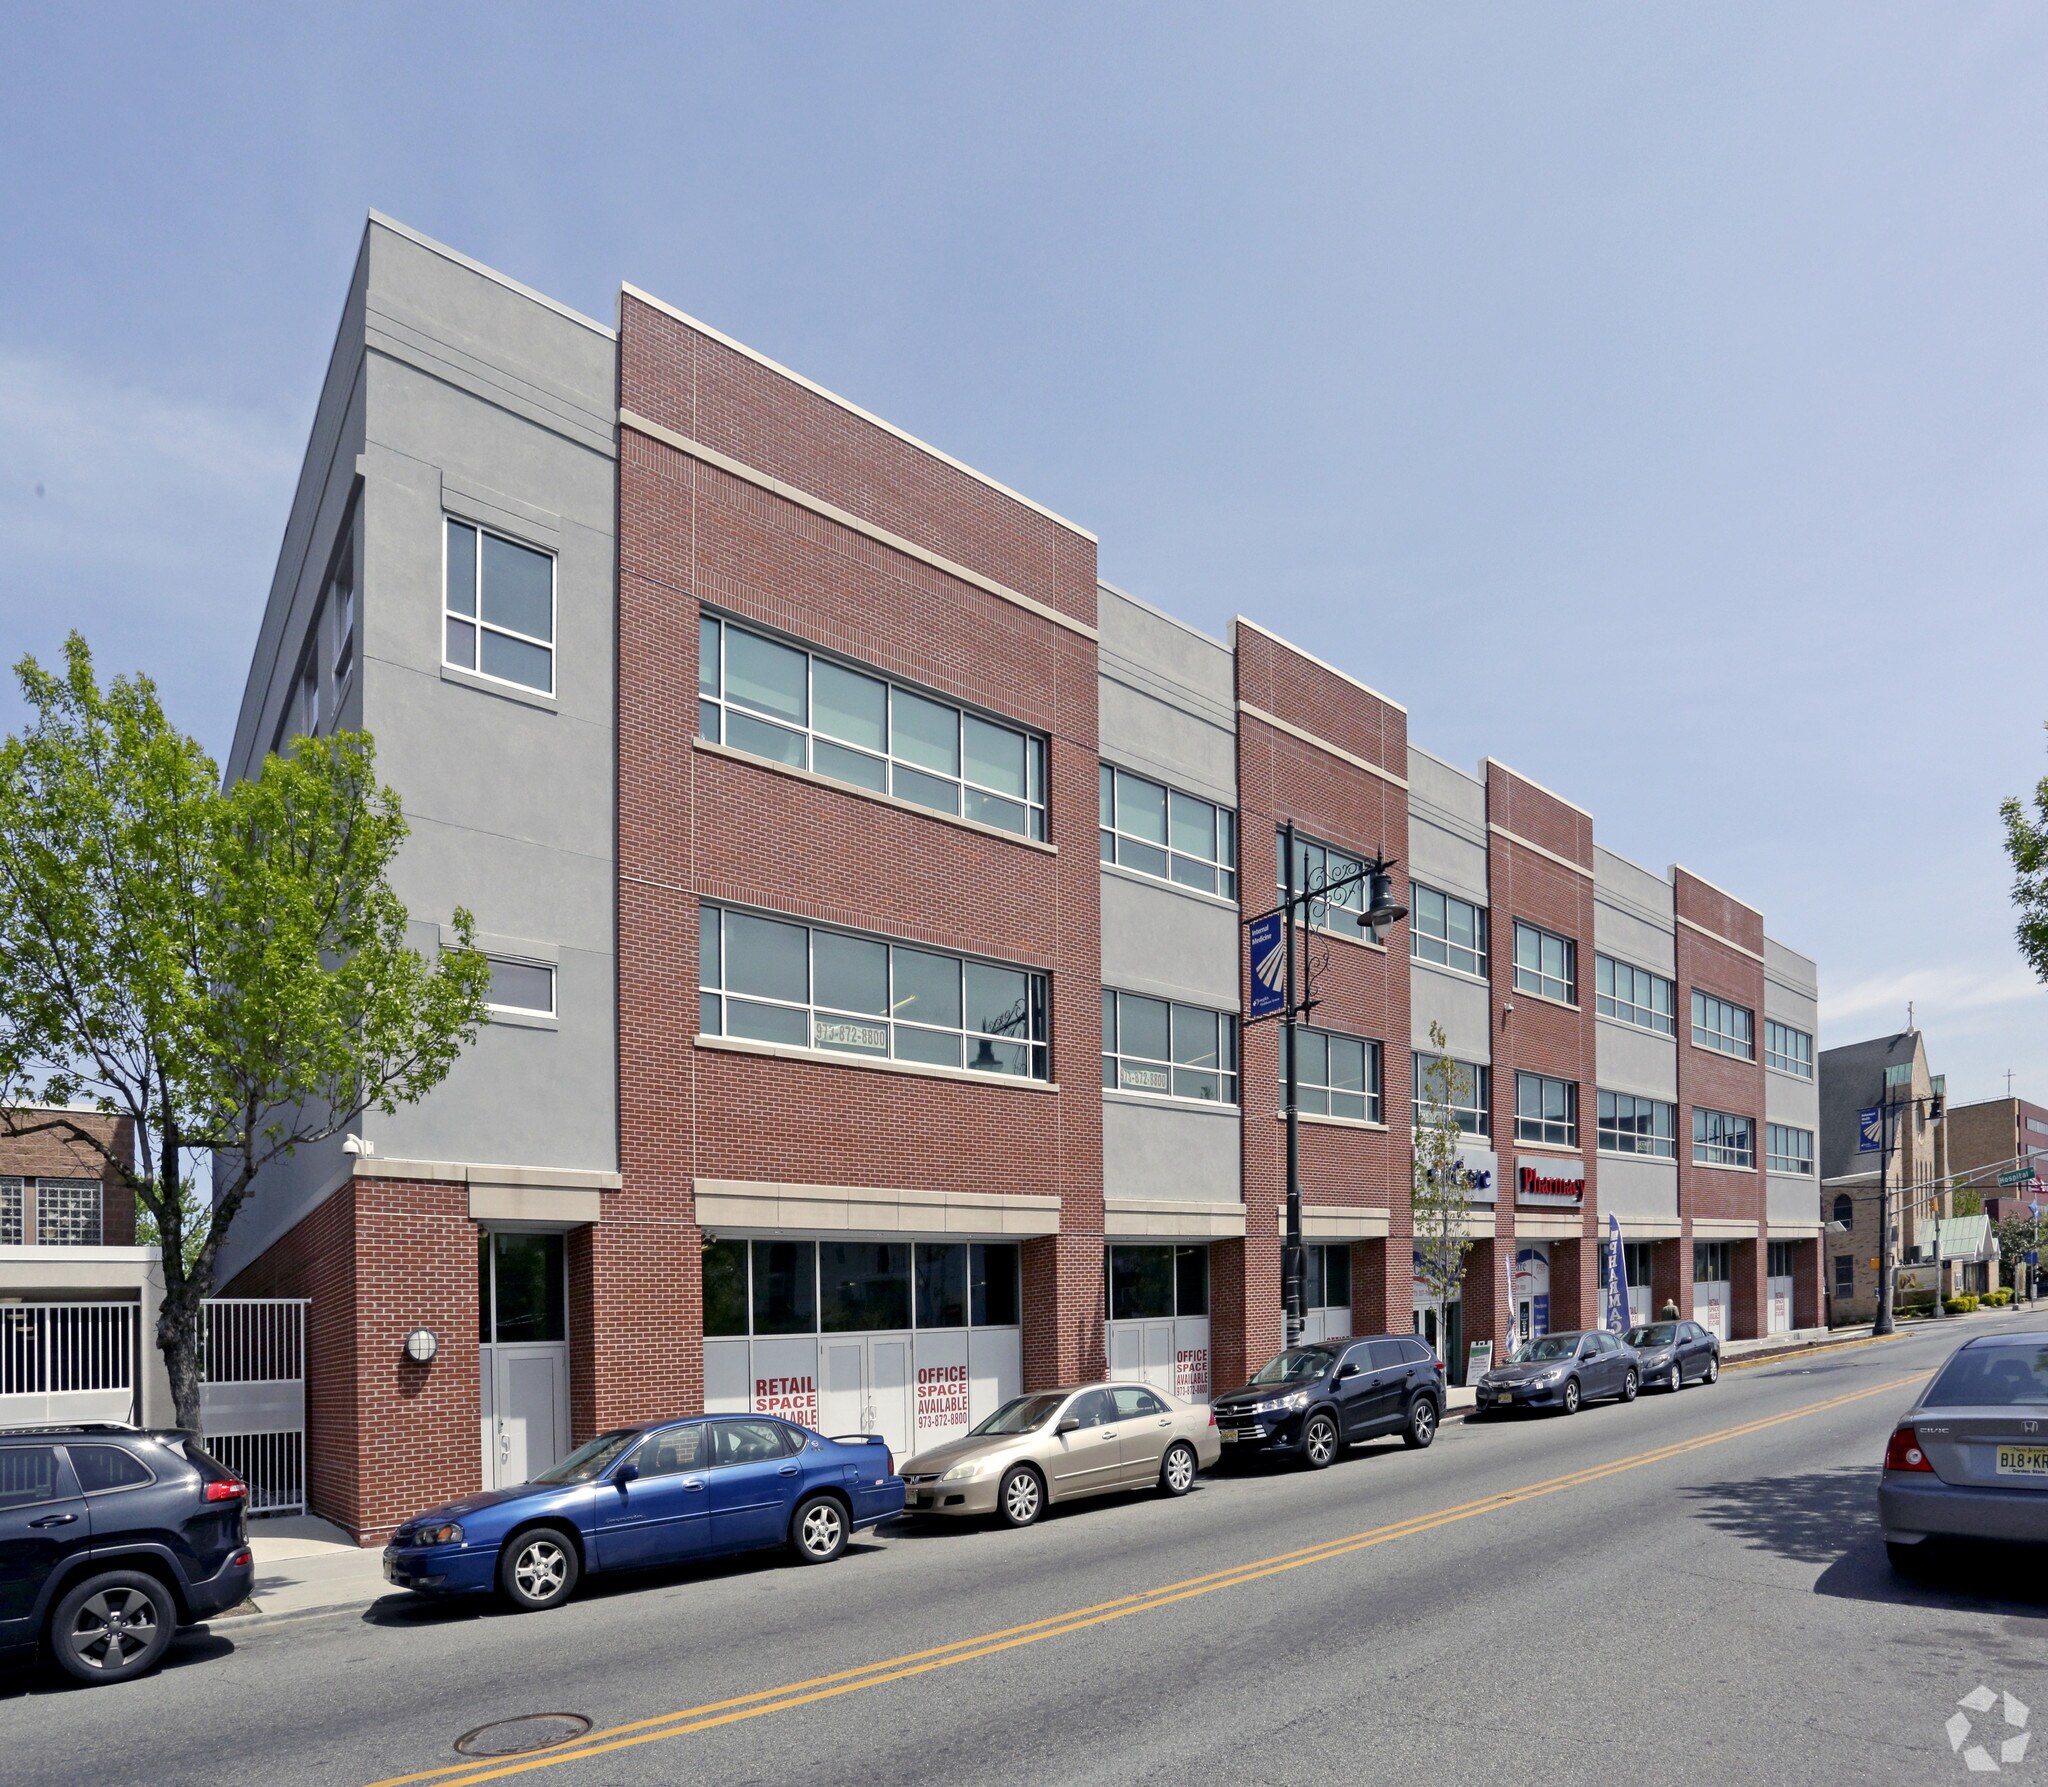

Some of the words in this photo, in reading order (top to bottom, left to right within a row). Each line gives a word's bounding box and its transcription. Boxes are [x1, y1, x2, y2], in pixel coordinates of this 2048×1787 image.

[1252, 924, 1269, 936] Internal
[1252, 934, 1272, 945] Medicine
[817, 1023, 885, 1046] 973-872-8800
[1519, 1166, 1585, 1202] Pharmacy
[2000, 1170, 2029, 1183] Hospital
[1177, 1349, 1208, 1363] OFFICE
[918, 1366, 966, 1384] OFFICE
[1177, 1362, 1208, 1373] SPACE
[756, 1376, 816, 1397] RETAIL
[1177, 1372, 1208, 1386] AVAILABLE
[917, 1383, 967, 1398] SPACE
[756, 1395, 816, 1412] SPACE
[918, 1396, 968, 1415] AVAILABLE
[918, 1412, 967, 1429] 973-872-8800
